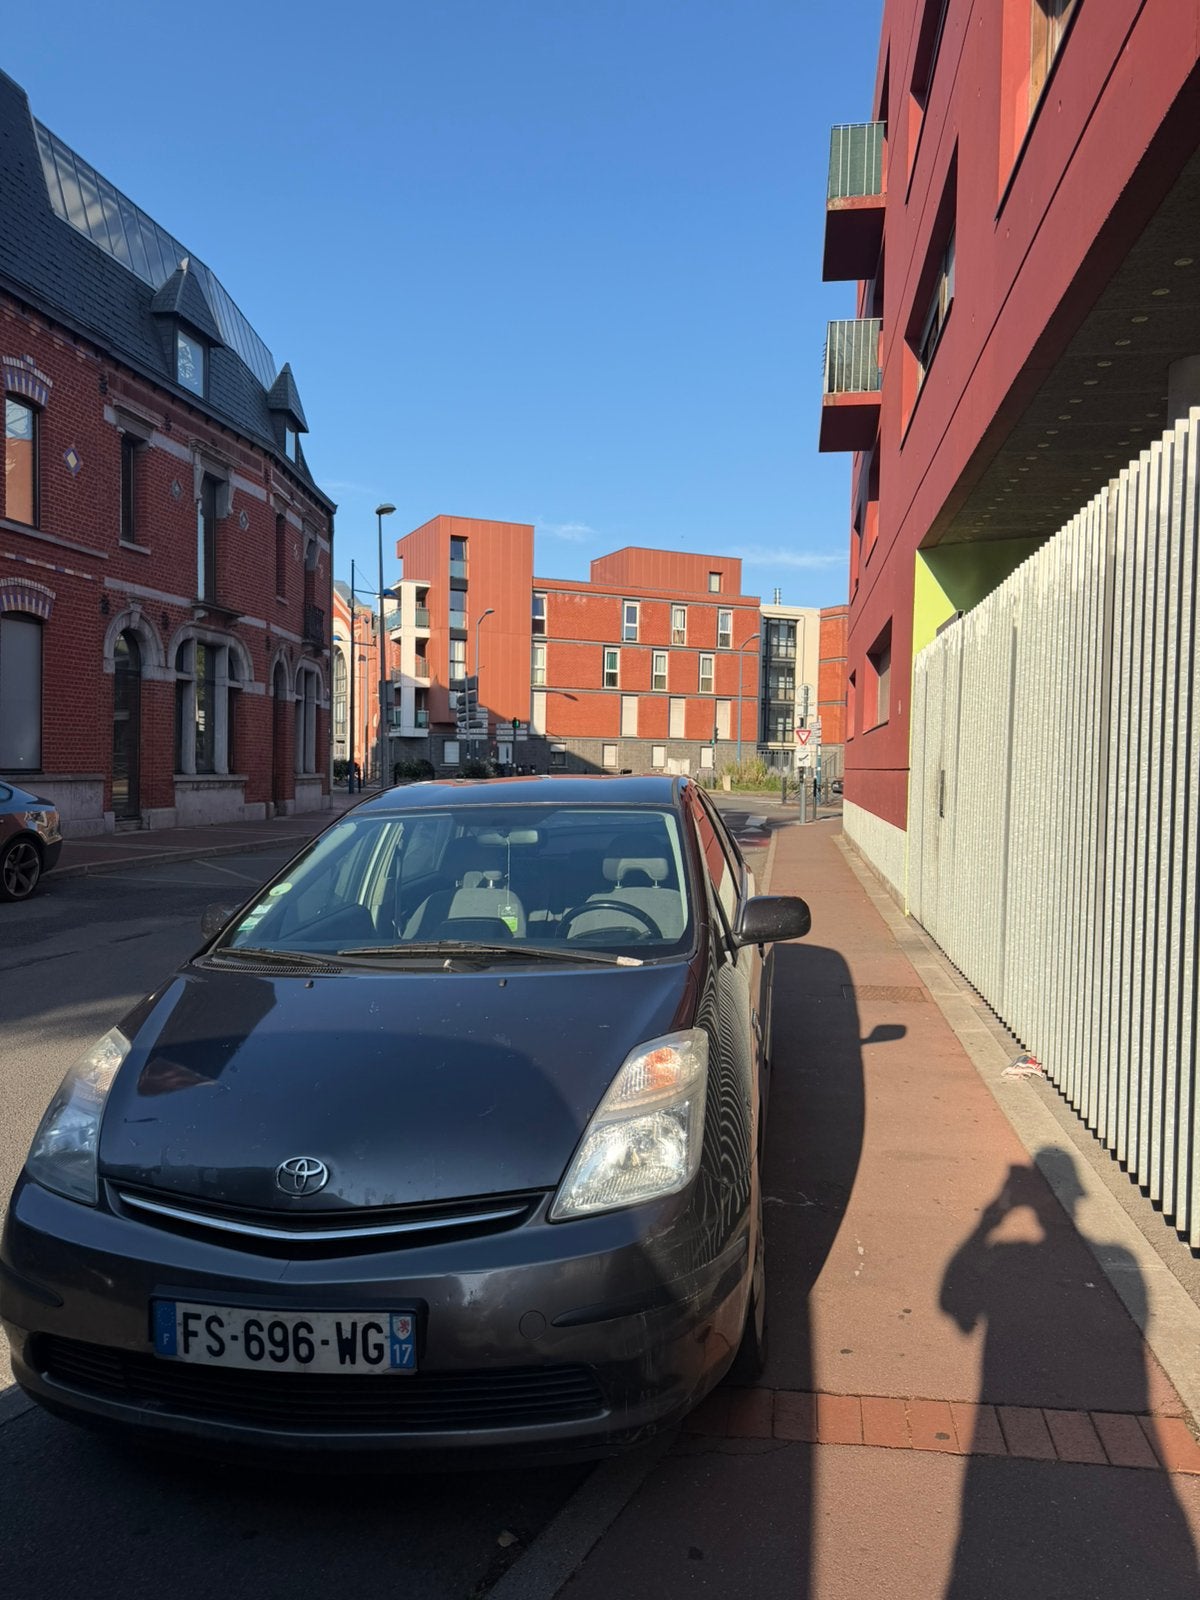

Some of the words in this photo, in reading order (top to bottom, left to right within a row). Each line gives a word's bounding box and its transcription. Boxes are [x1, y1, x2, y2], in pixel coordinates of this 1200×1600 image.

[163, 1333, 170, 1345] F
[182, 1312, 385, 1366] FS-696-WG
[393, 1344, 413, 1364] 17
